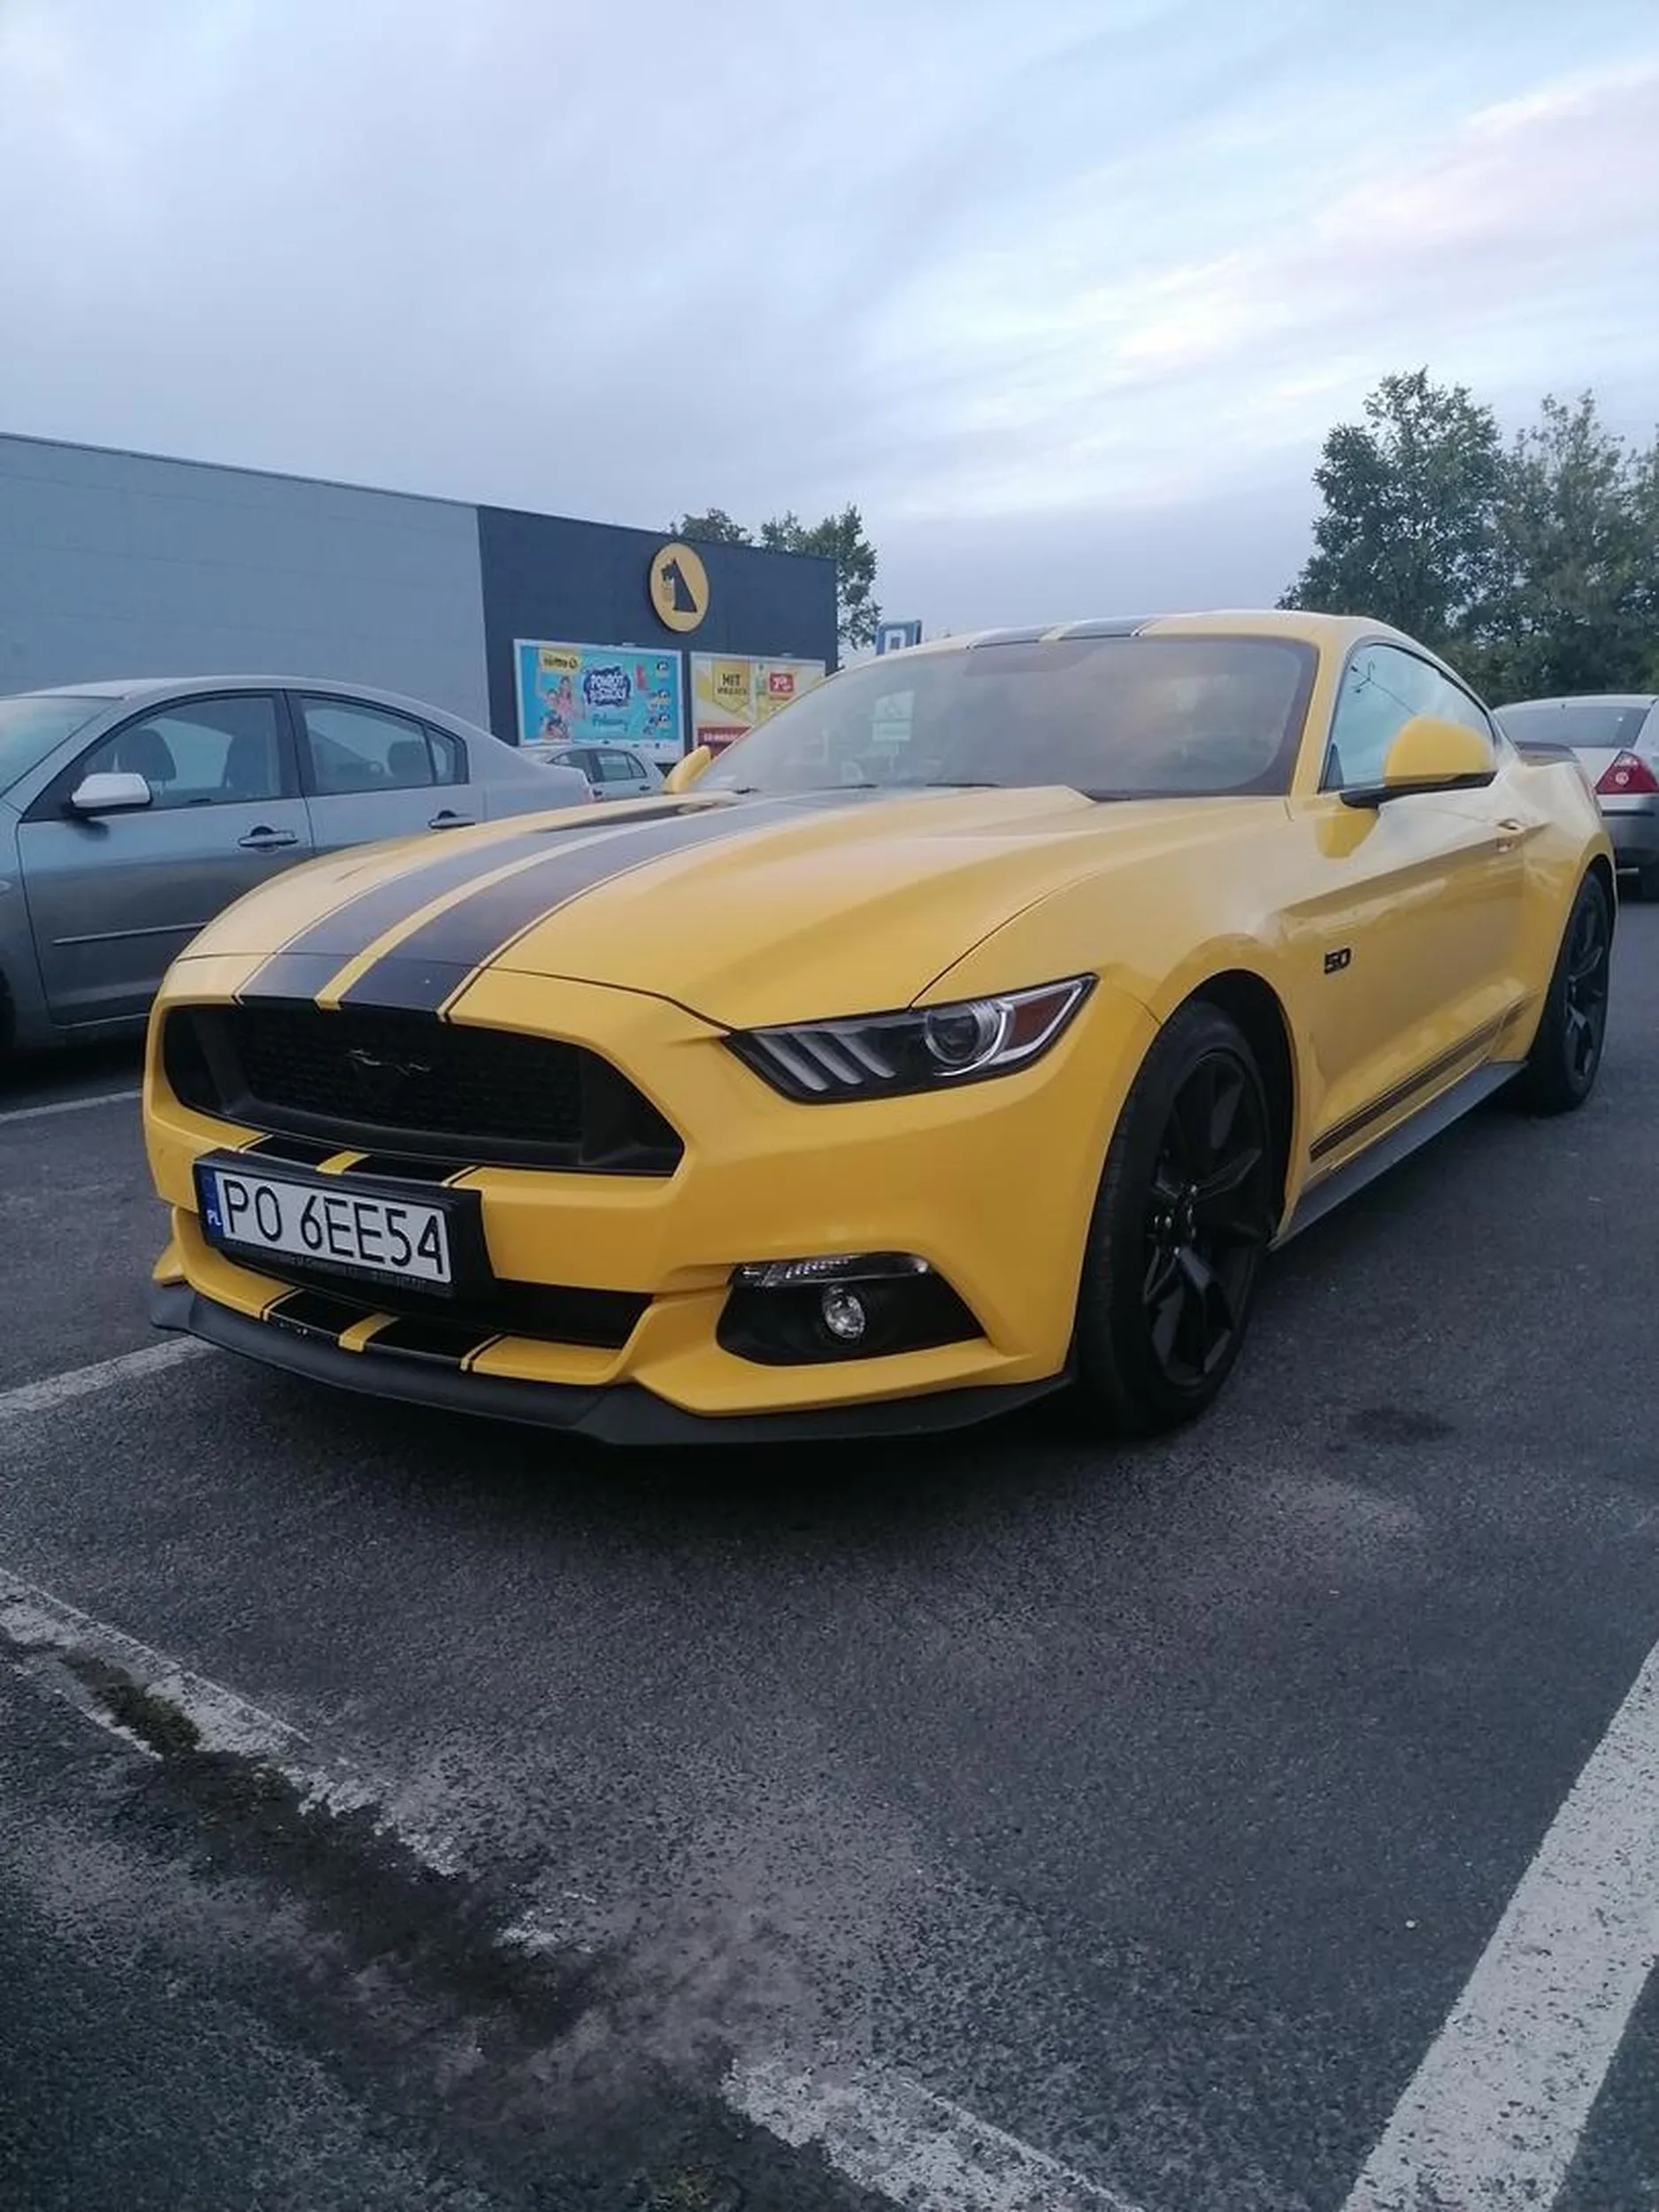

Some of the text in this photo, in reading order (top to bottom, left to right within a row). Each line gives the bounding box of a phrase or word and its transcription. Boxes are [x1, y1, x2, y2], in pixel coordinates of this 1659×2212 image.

[207, 1210, 222, 1226] PL
[223, 1179, 443, 1275] PO 6EE54
